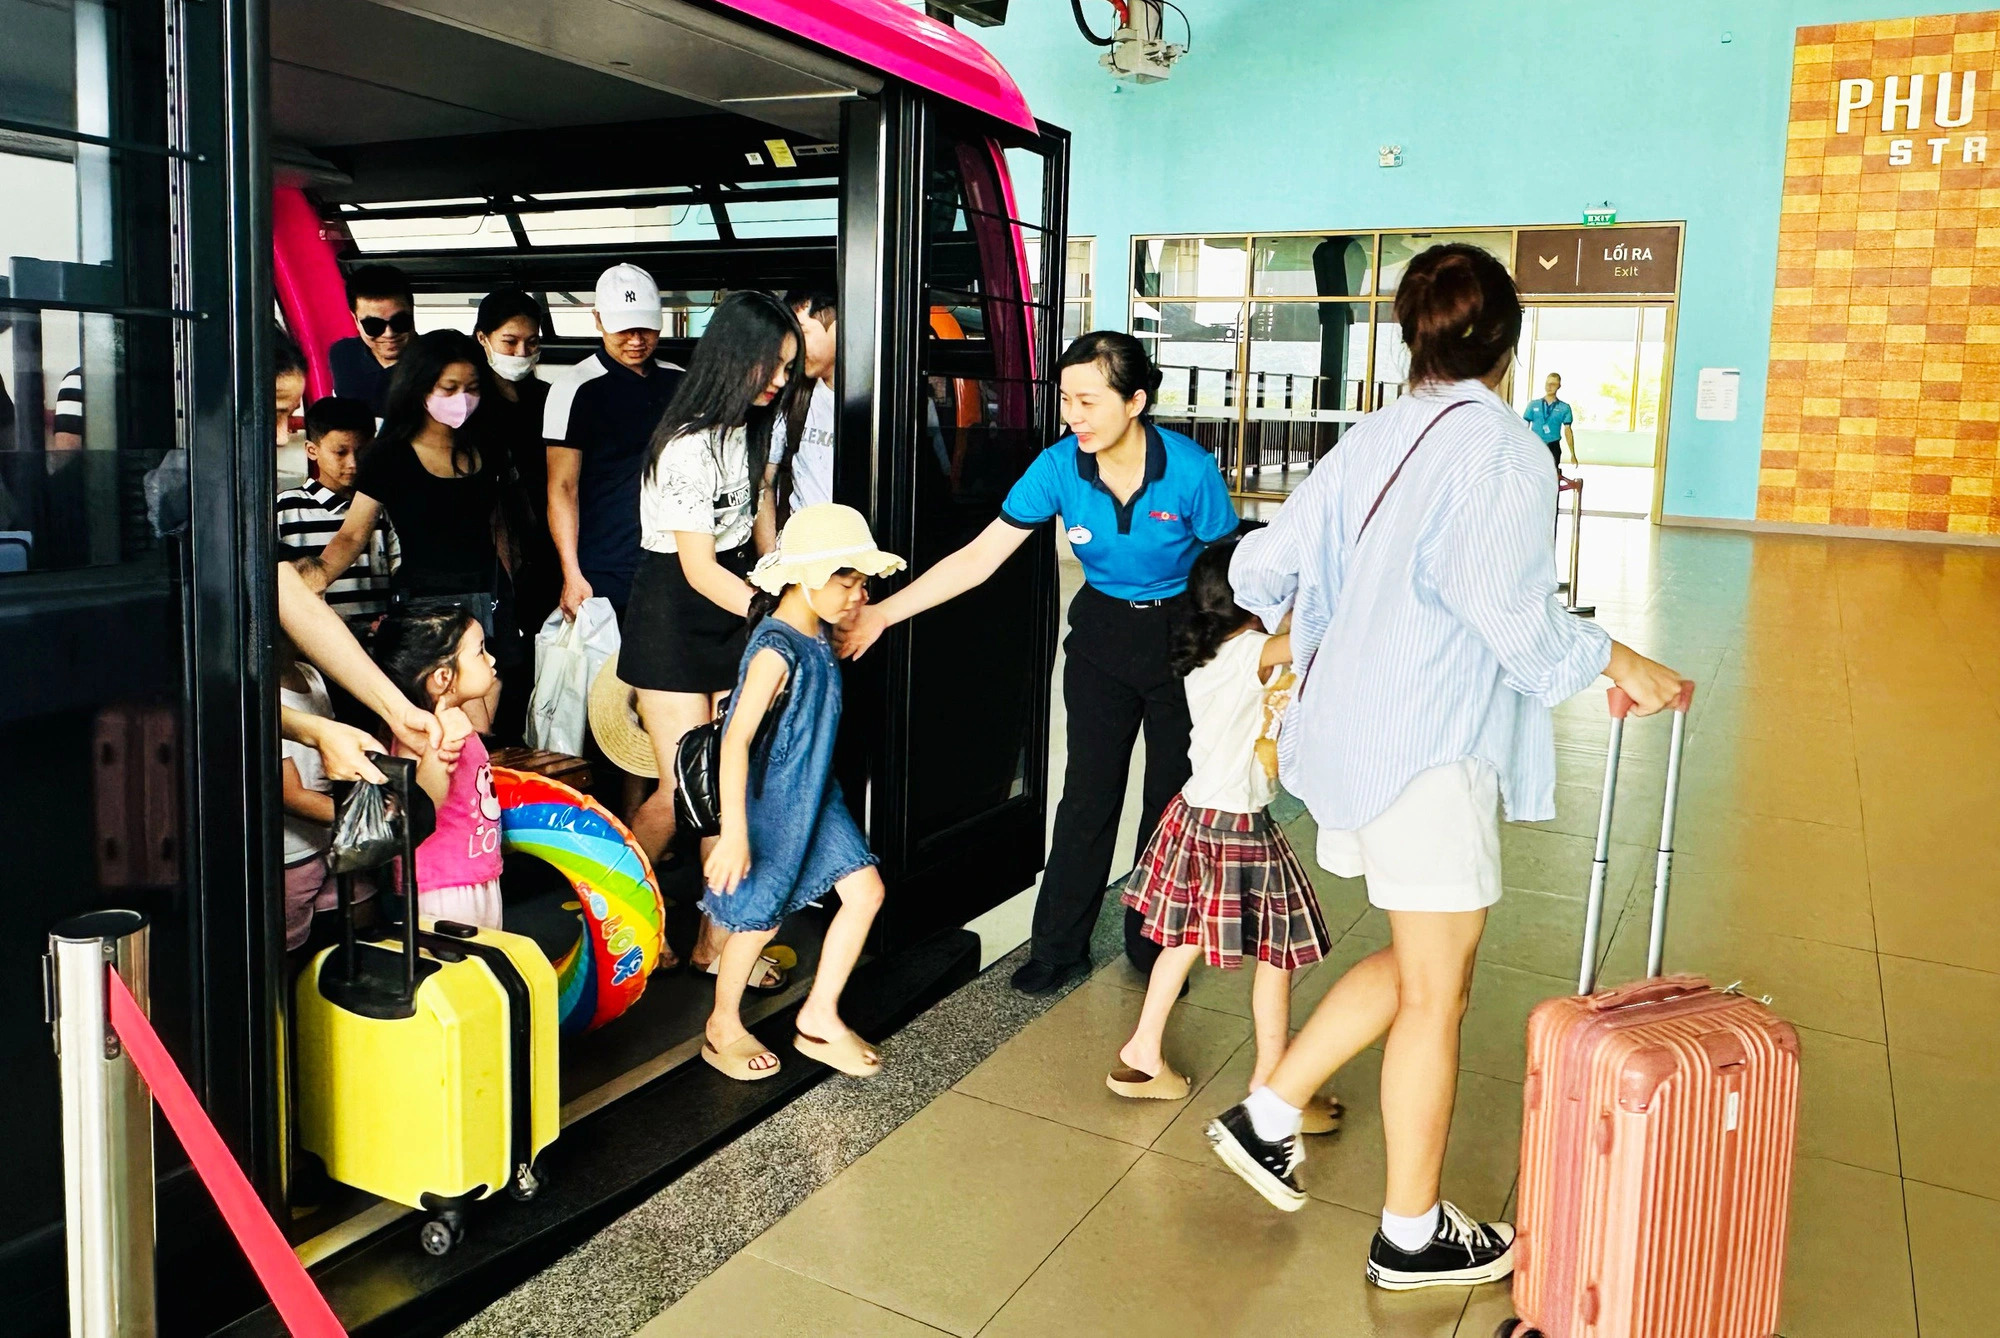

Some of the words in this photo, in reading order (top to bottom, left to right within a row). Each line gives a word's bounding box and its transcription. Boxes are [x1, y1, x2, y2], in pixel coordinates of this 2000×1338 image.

[1836, 70, 1977, 133] PHU
[1587, 213, 1612, 223] EXIT
[1603, 243, 1628, 261] LỐI
[1631, 247, 1653, 261] RA
[1614, 266, 1639, 277] Exit
